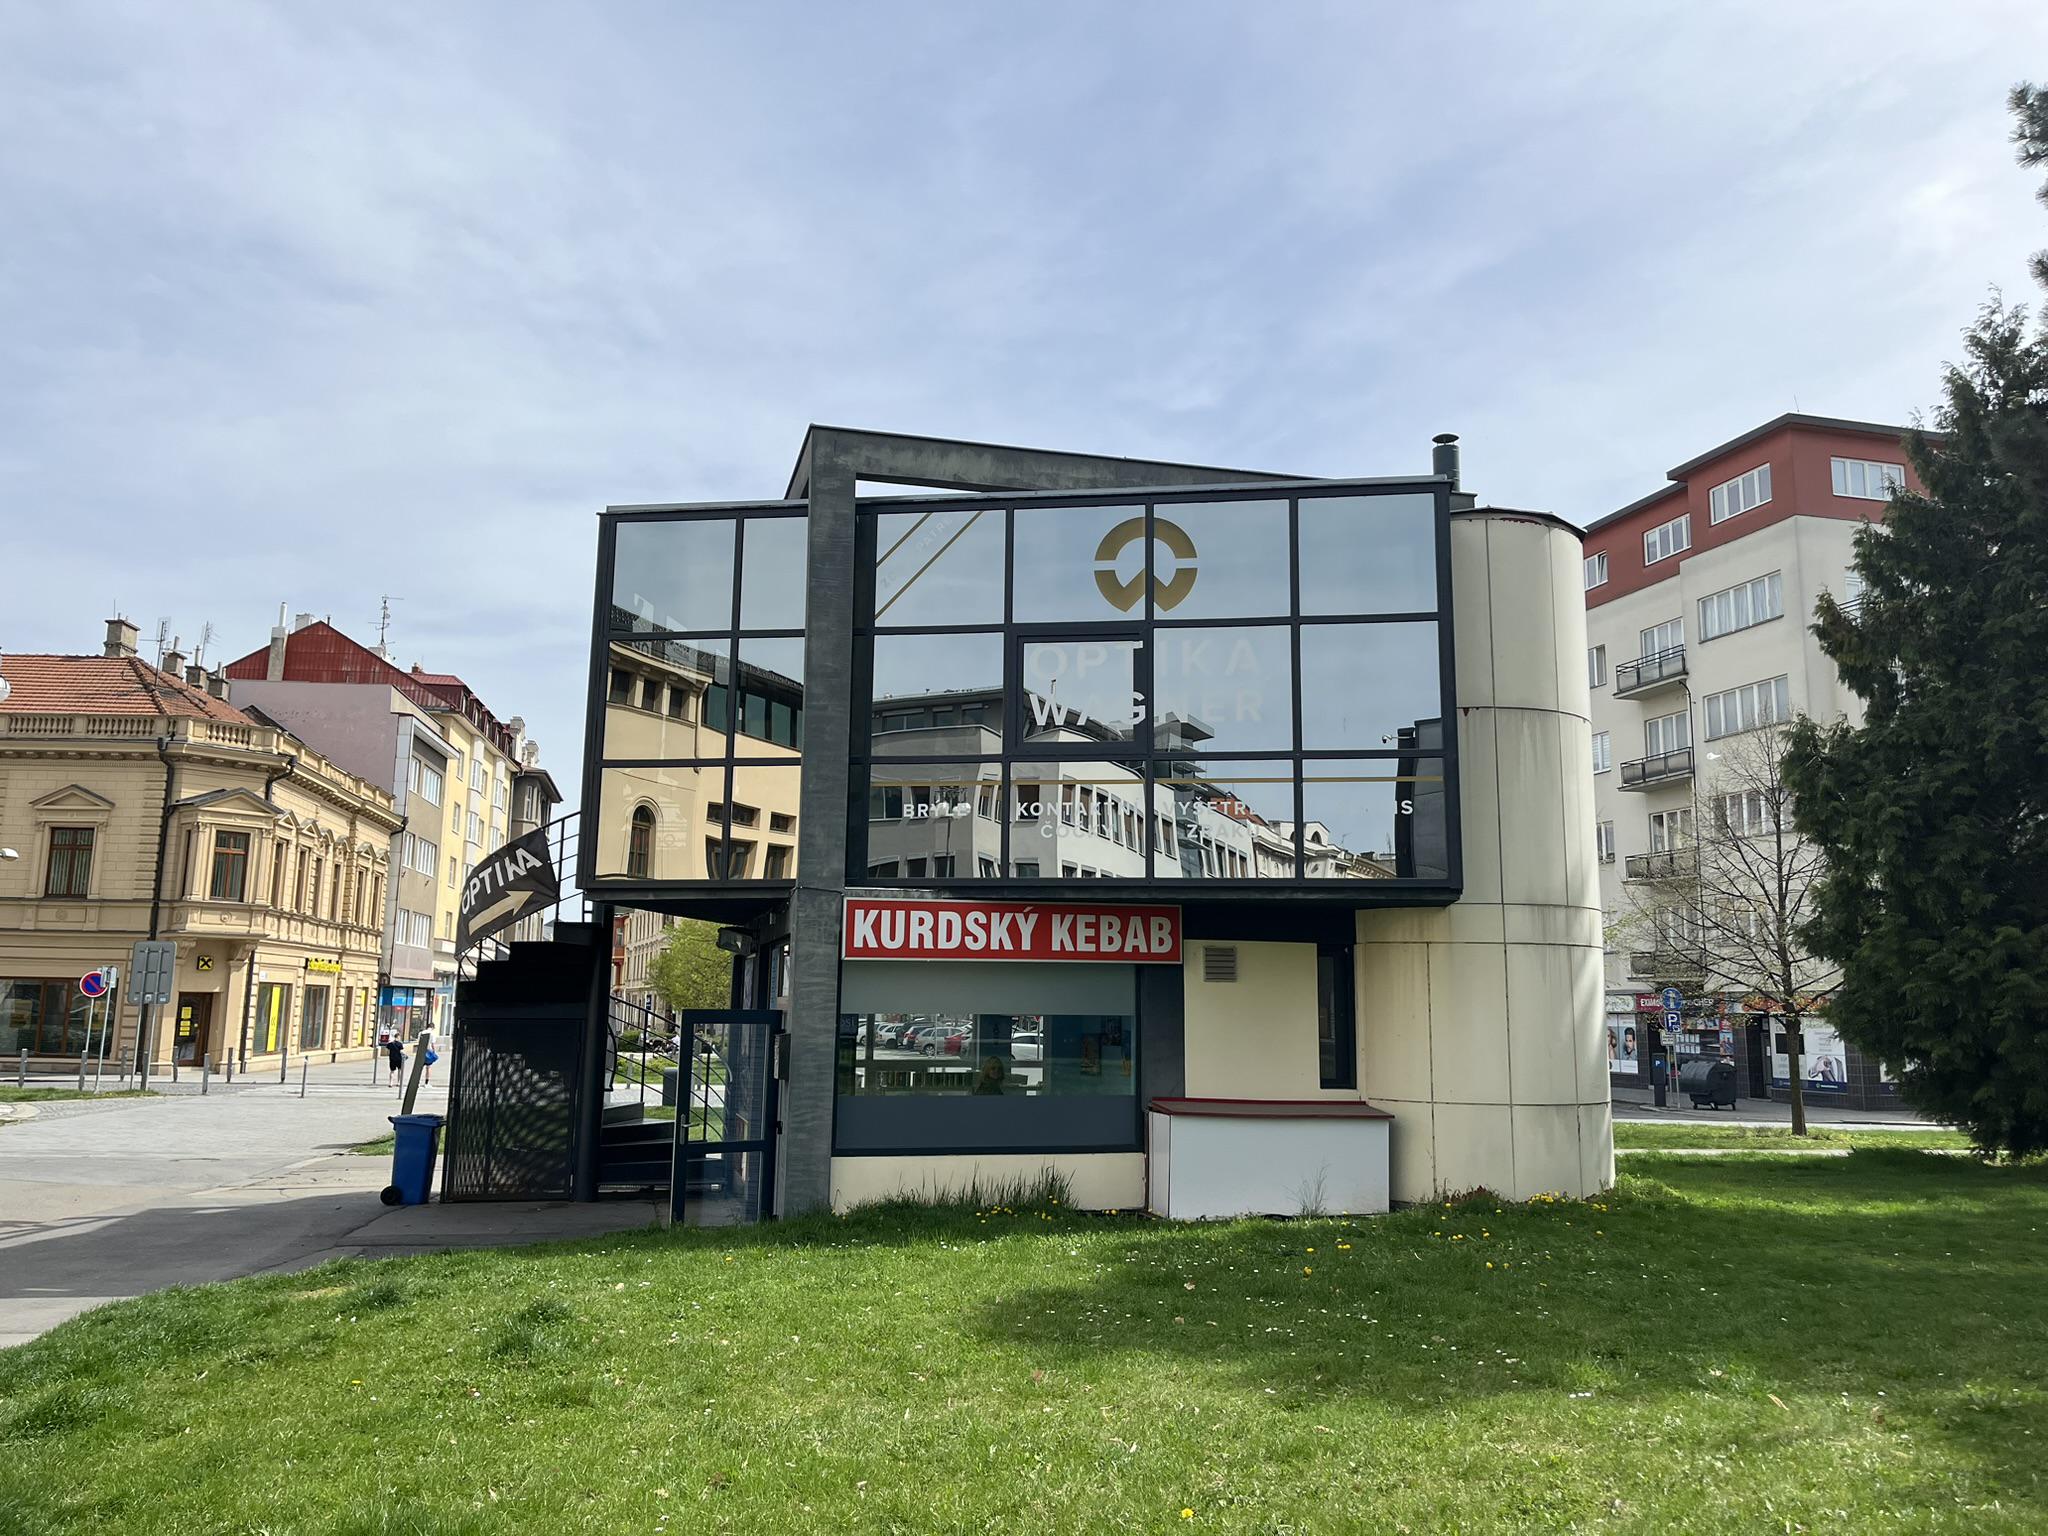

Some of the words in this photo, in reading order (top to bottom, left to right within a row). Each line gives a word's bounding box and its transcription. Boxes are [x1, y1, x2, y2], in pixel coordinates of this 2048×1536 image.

[1029, 639, 1260, 678] OPTIKA
[903, 799, 968, 817] BRÝLE
[462, 847, 543, 914] OPTIKA
[853, 907, 1039, 951] KURDSKÝ
[1051, 913, 1173, 953] KEBAB
[1668, 1014, 1678, 1026] P
